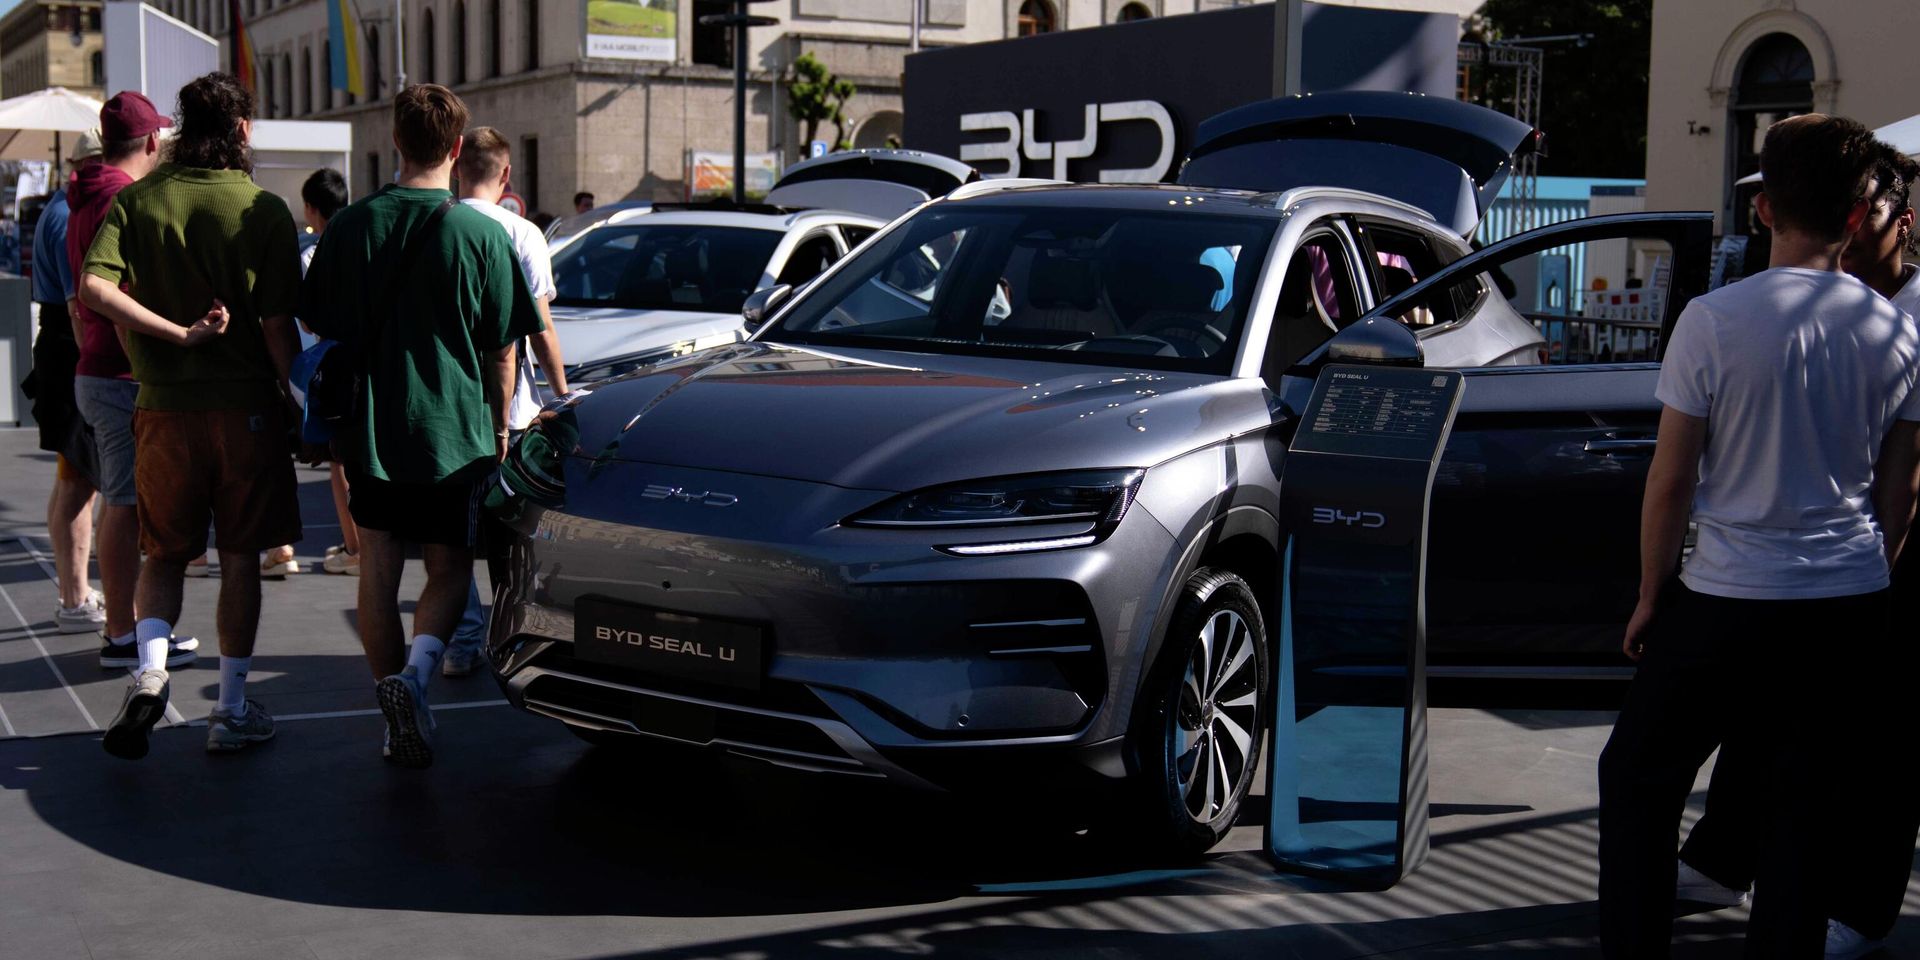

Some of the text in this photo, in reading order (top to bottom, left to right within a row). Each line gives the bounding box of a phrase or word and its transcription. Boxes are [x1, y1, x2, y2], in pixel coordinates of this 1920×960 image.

[960, 100, 1176, 184] BYD
[641, 484, 738, 507] BYD
[1313, 507, 1385, 528] BYD
[595, 626, 736, 662] BYD SEAL U
